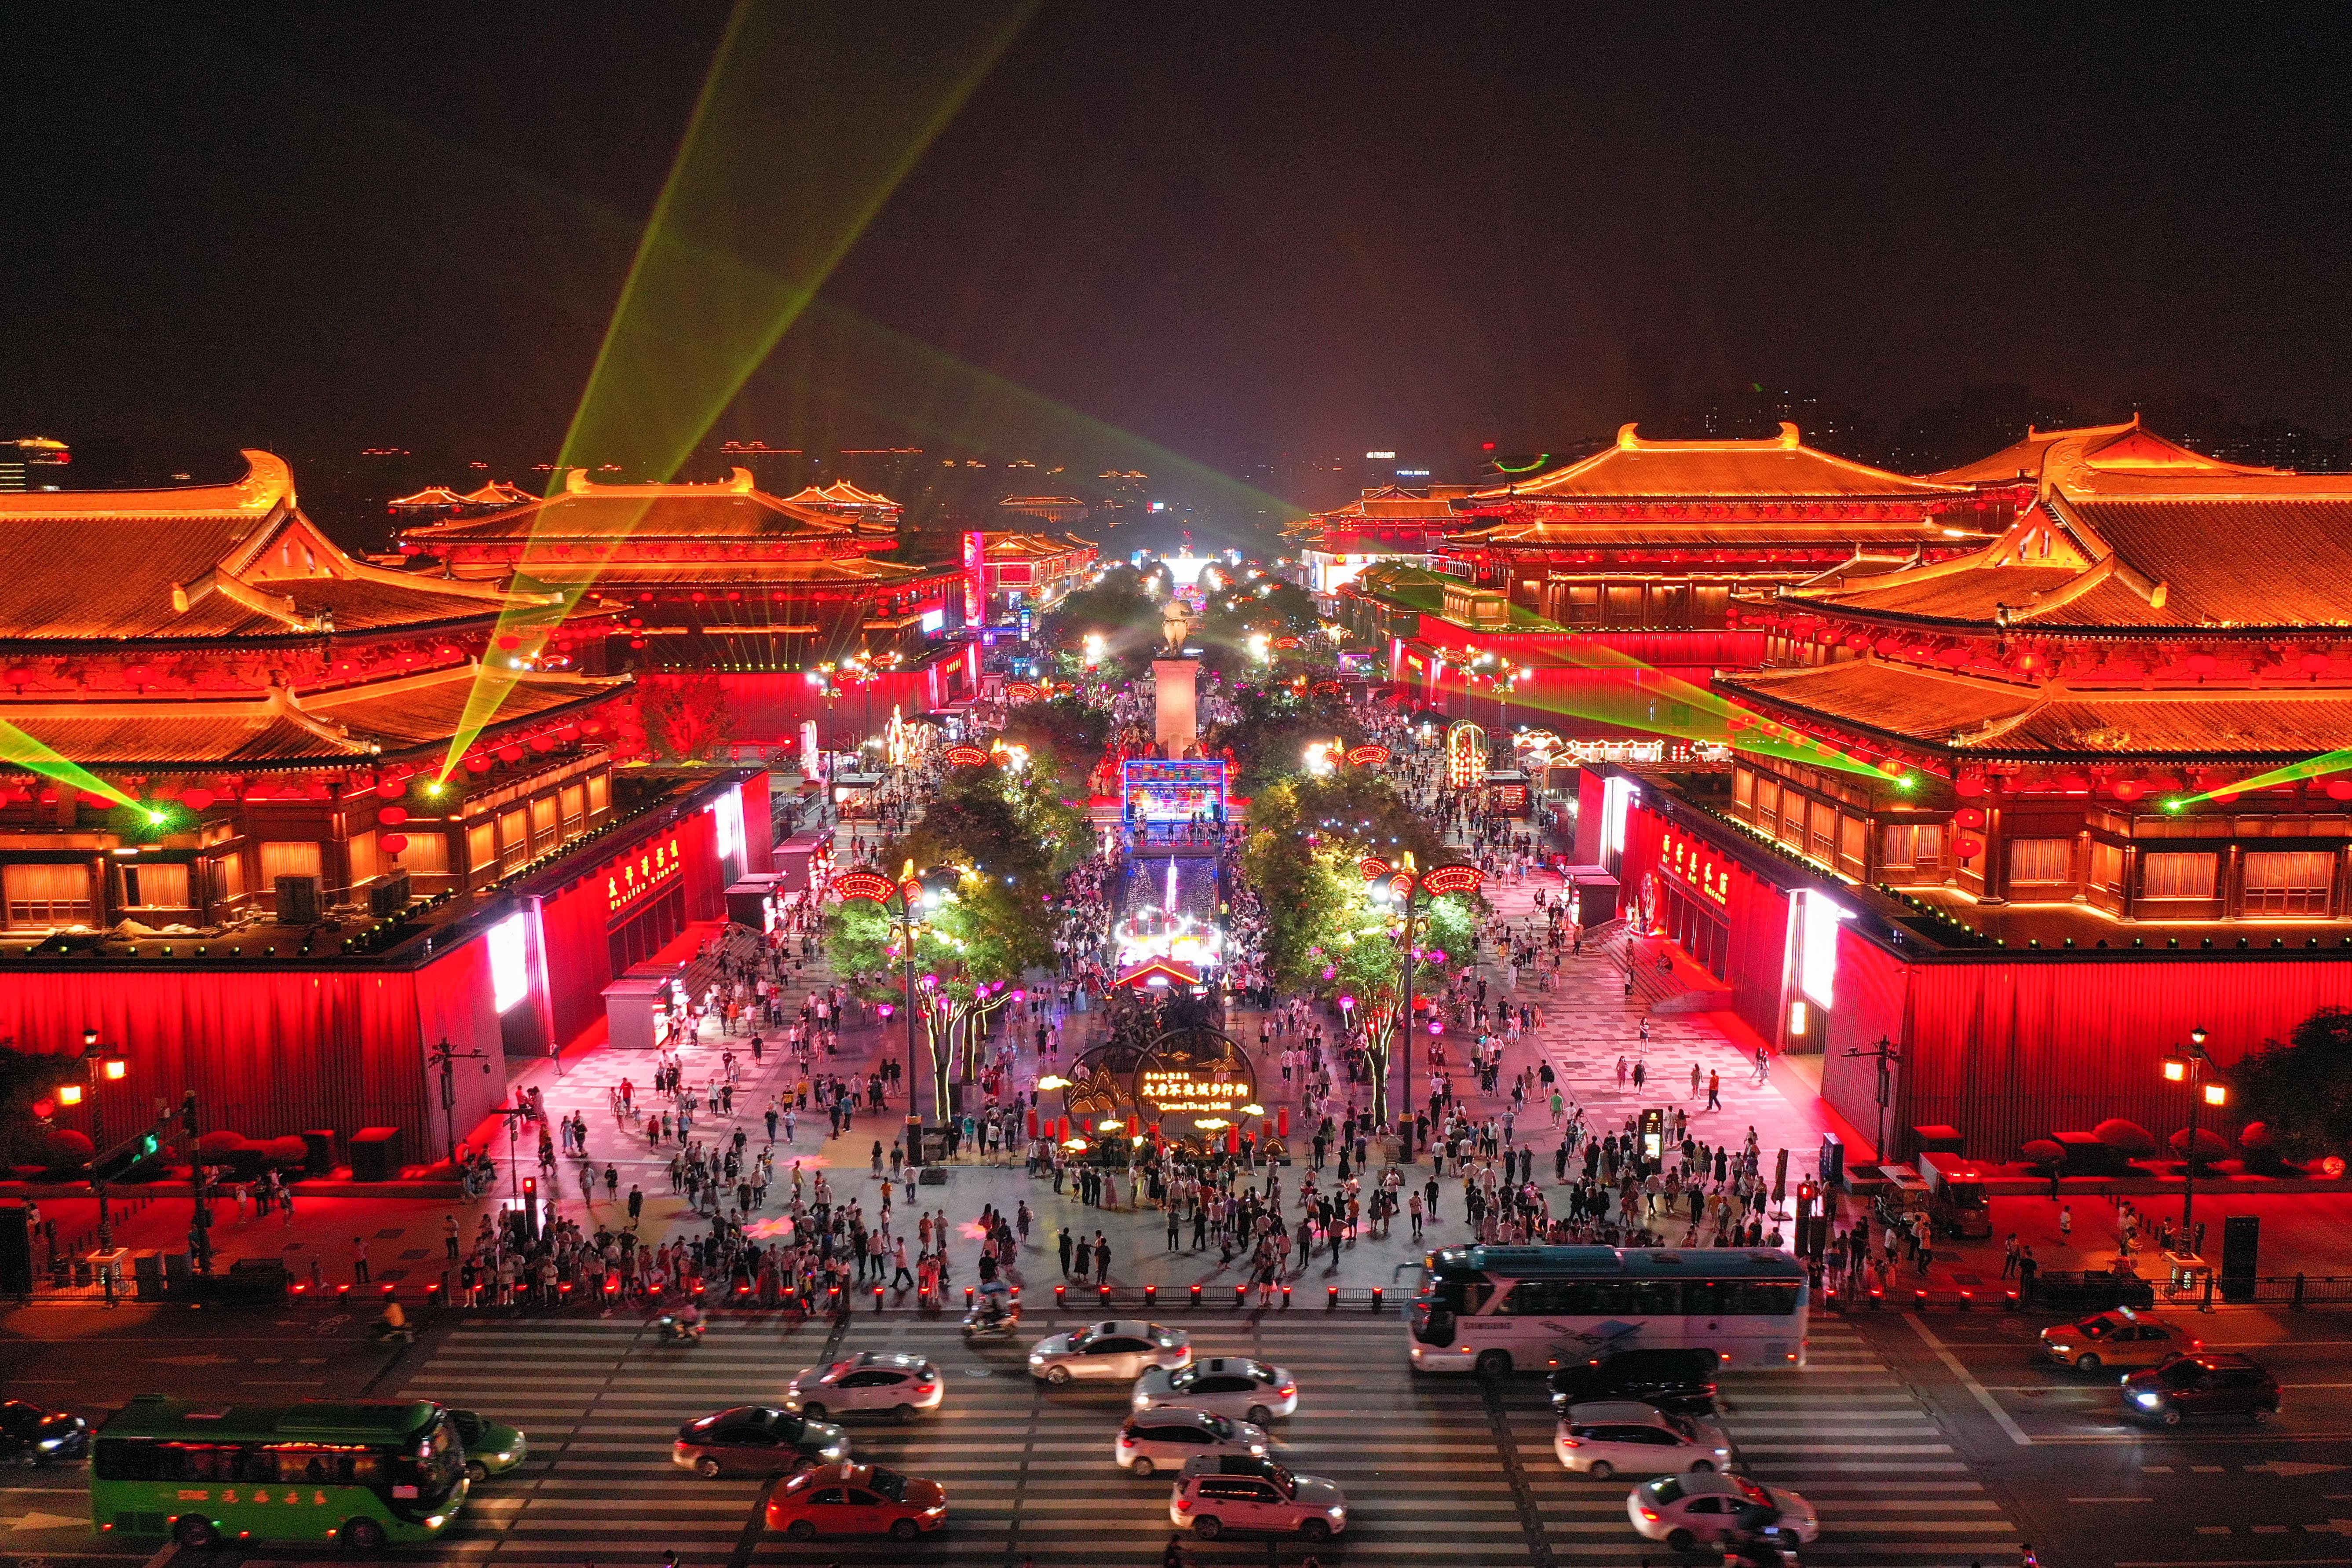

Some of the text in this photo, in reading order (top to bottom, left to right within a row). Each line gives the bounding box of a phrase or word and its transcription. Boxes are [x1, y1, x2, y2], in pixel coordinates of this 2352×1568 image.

[1142, 1082, 1249, 1097] 大唐不夜城步行街
[1159, 1102, 1231, 1111] Grand Tang Mall
